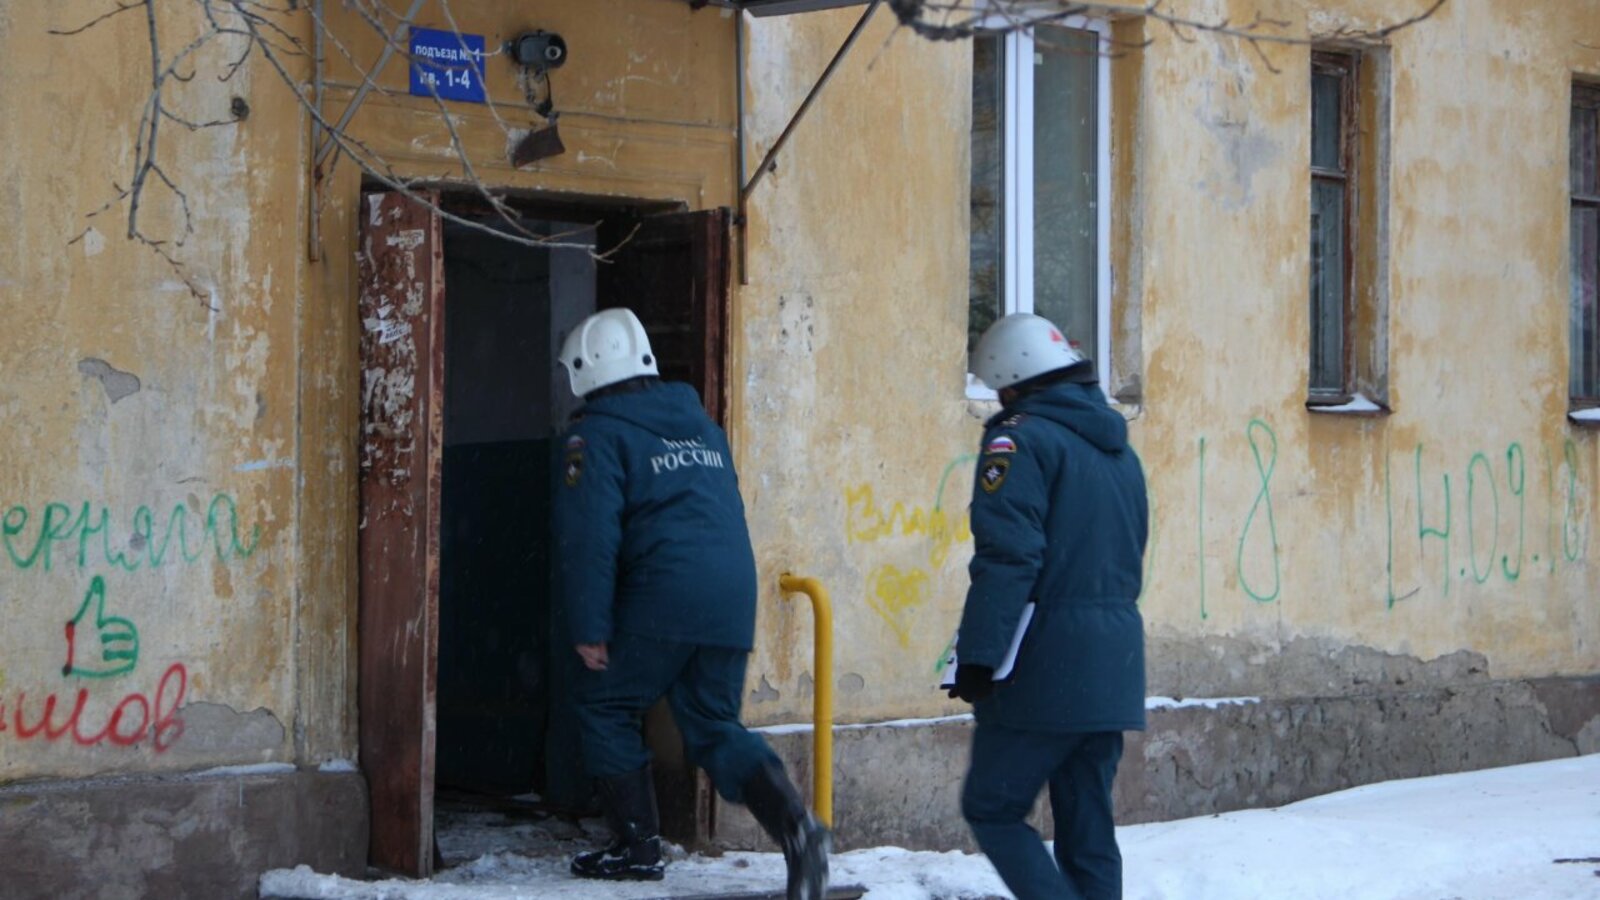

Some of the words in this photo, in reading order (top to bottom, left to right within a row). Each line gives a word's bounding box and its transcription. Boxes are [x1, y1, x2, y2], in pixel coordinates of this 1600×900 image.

[415, 45, 457, 61] ПОДЪЕЗД
[474, 48, 480, 62] 1
[445, 68, 471, 89] 1-4
[650, 449, 724, 474] РОССИИ
[0, 662, 188, 754] шов
